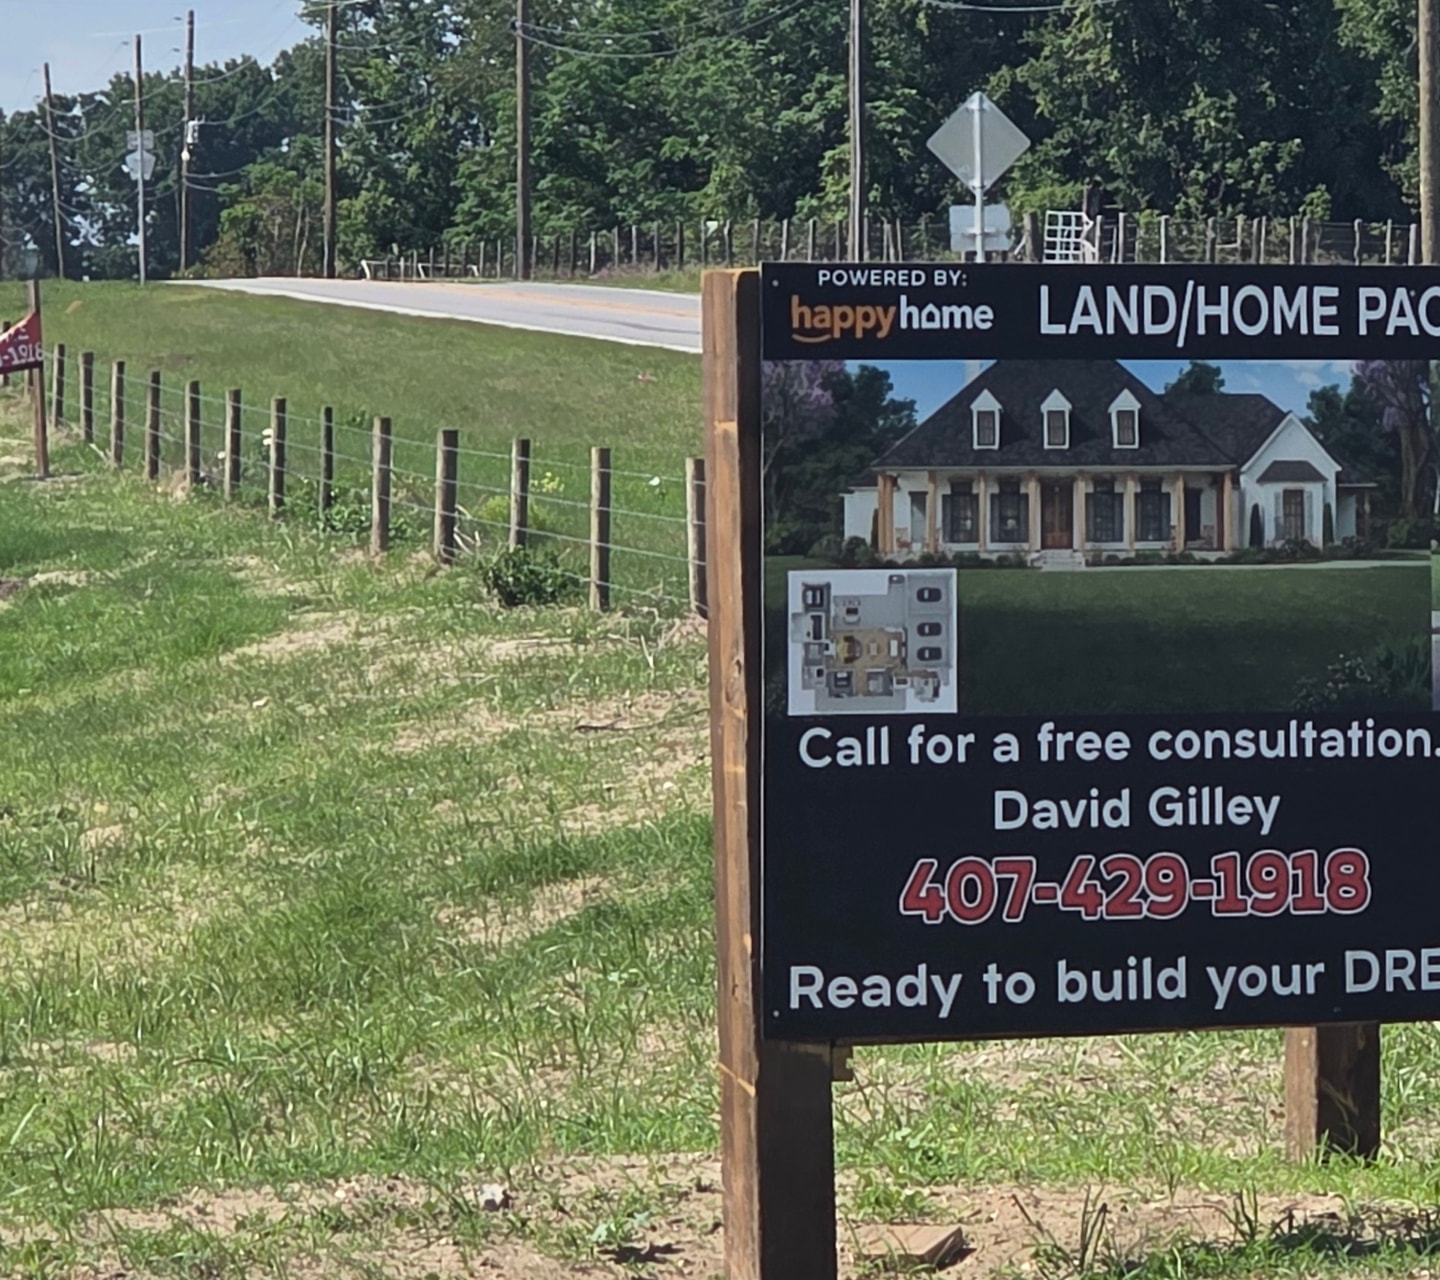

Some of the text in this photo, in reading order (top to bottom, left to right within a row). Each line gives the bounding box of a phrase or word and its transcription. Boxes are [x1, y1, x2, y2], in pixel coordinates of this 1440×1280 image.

[817, 269, 968, 287] POWERED BY:
[1039, 279, 1341, 348] LAND/HOME
[799, 726, 891, 767] Call
[907, 724, 976, 763] for
[992, 734, 1021, 761] a
[1037, 722, 1131, 761] free
[993, 785, 1281, 835] David Gilley
[900, 847, 1372, 925] 407-429-1918
[788, 963, 963, 1018] Ready
[982, 963, 1037, 1005] to
[1057, 956, 1188, 1004] build
[1207, 961, 1326, 1010] your
